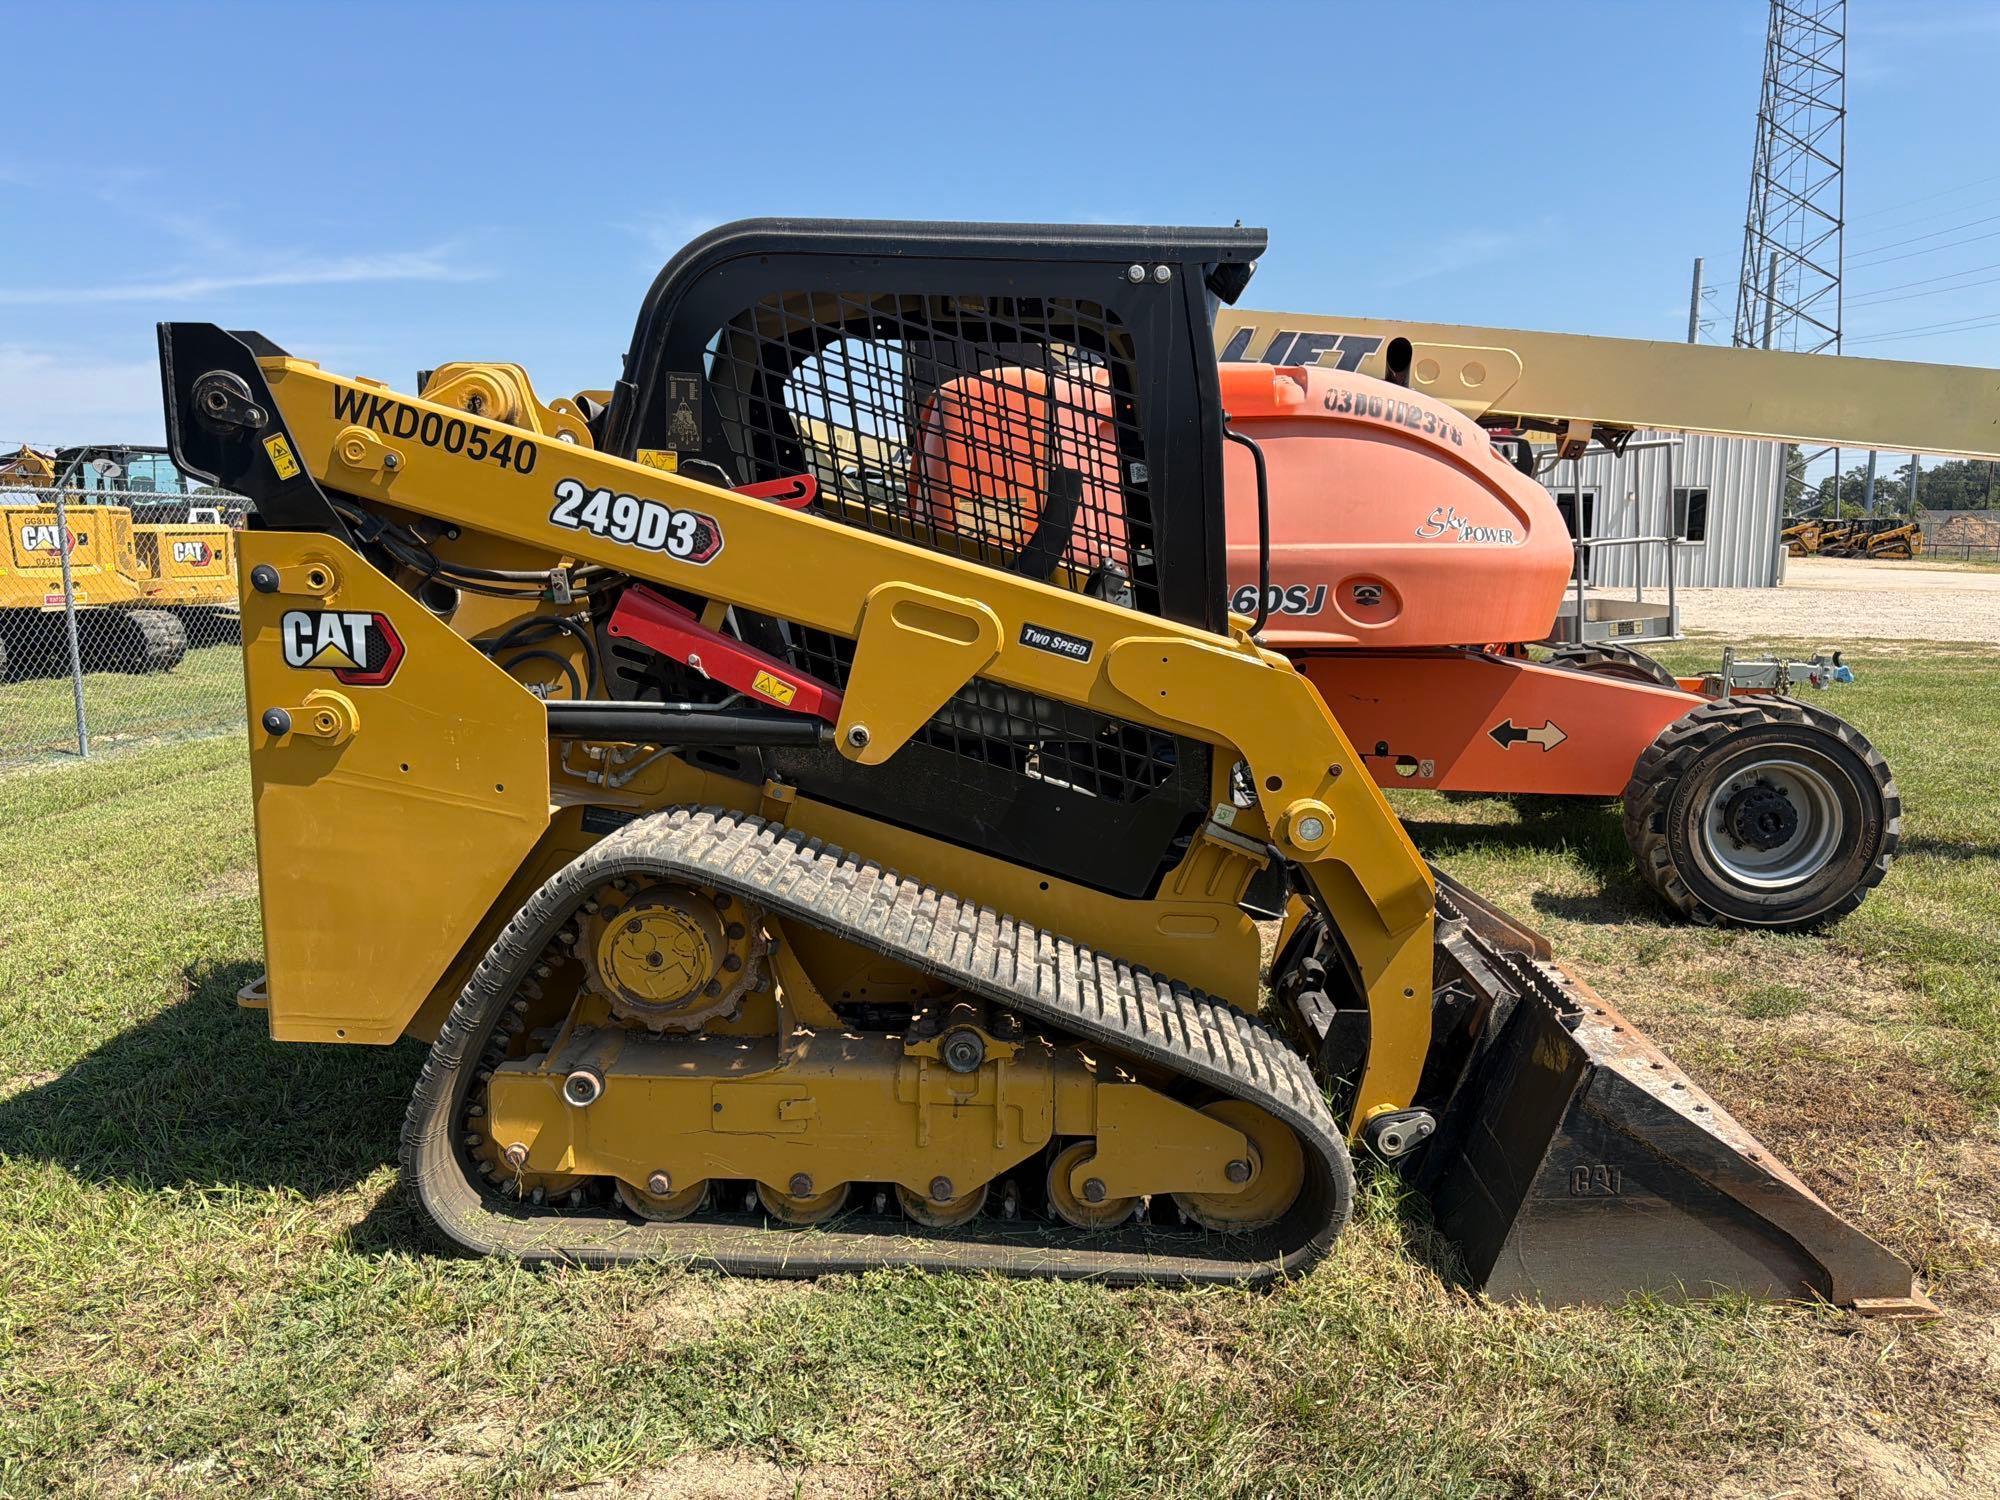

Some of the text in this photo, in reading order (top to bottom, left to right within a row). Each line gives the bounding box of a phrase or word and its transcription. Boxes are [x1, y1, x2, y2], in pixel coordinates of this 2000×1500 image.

[1217, 326, 1386, 373] LIFT
[334, 384, 537, 475] WKD00540
[21, 525, 61, 551] CAT
[551, 480, 697, 557] 249D3
[1415, 505, 1515, 545] Sky POWER
[173, 541, 203, 564] CAT
[1227, 583, 1328, 616] 60SJ
[282, 610, 373, 669] CAT
[1570, 1164, 1624, 1196] CAT
